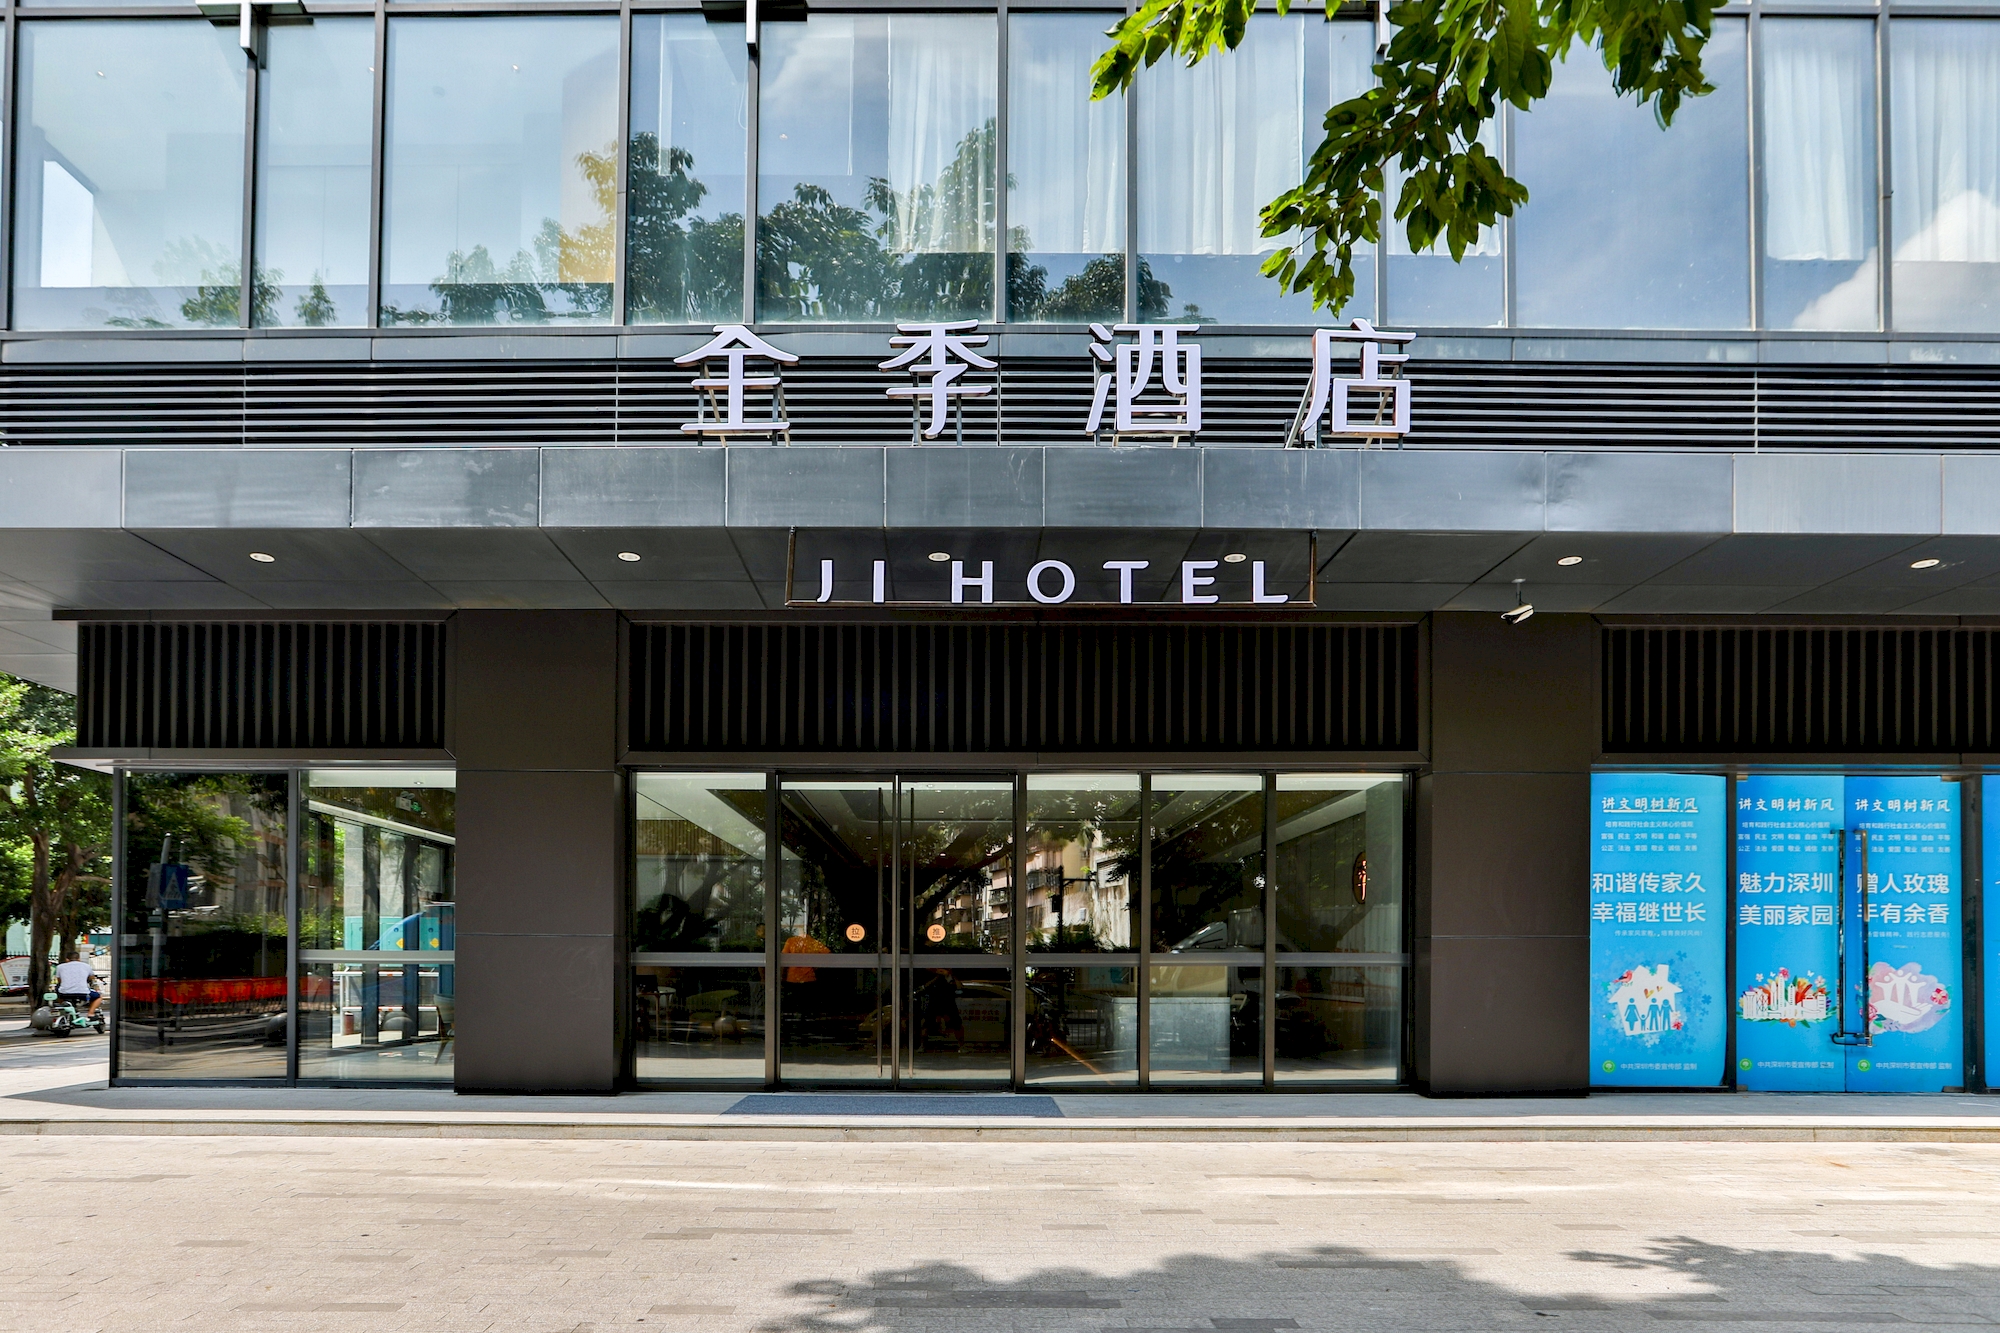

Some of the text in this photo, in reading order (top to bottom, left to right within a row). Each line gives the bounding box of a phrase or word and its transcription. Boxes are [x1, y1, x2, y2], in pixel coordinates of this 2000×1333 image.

[673, 318, 1418, 439] 全季酒店
[816, 559, 1289, 604] JI HOTEL
[1602, 797, 1697, 810] 讲文明树新风
[1738, 798, 1834, 811] 讲文明树新风
[1855, 799, 1950, 812] 讲文明树新风
[1592, 872, 1706, 893] 和谐传家久
[1739, 872, 1833, 893] 魅力深圳
[1592, 902, 1706, 923] 幸福继世长
[1739, 904, 1833, 926] 美丽家园
